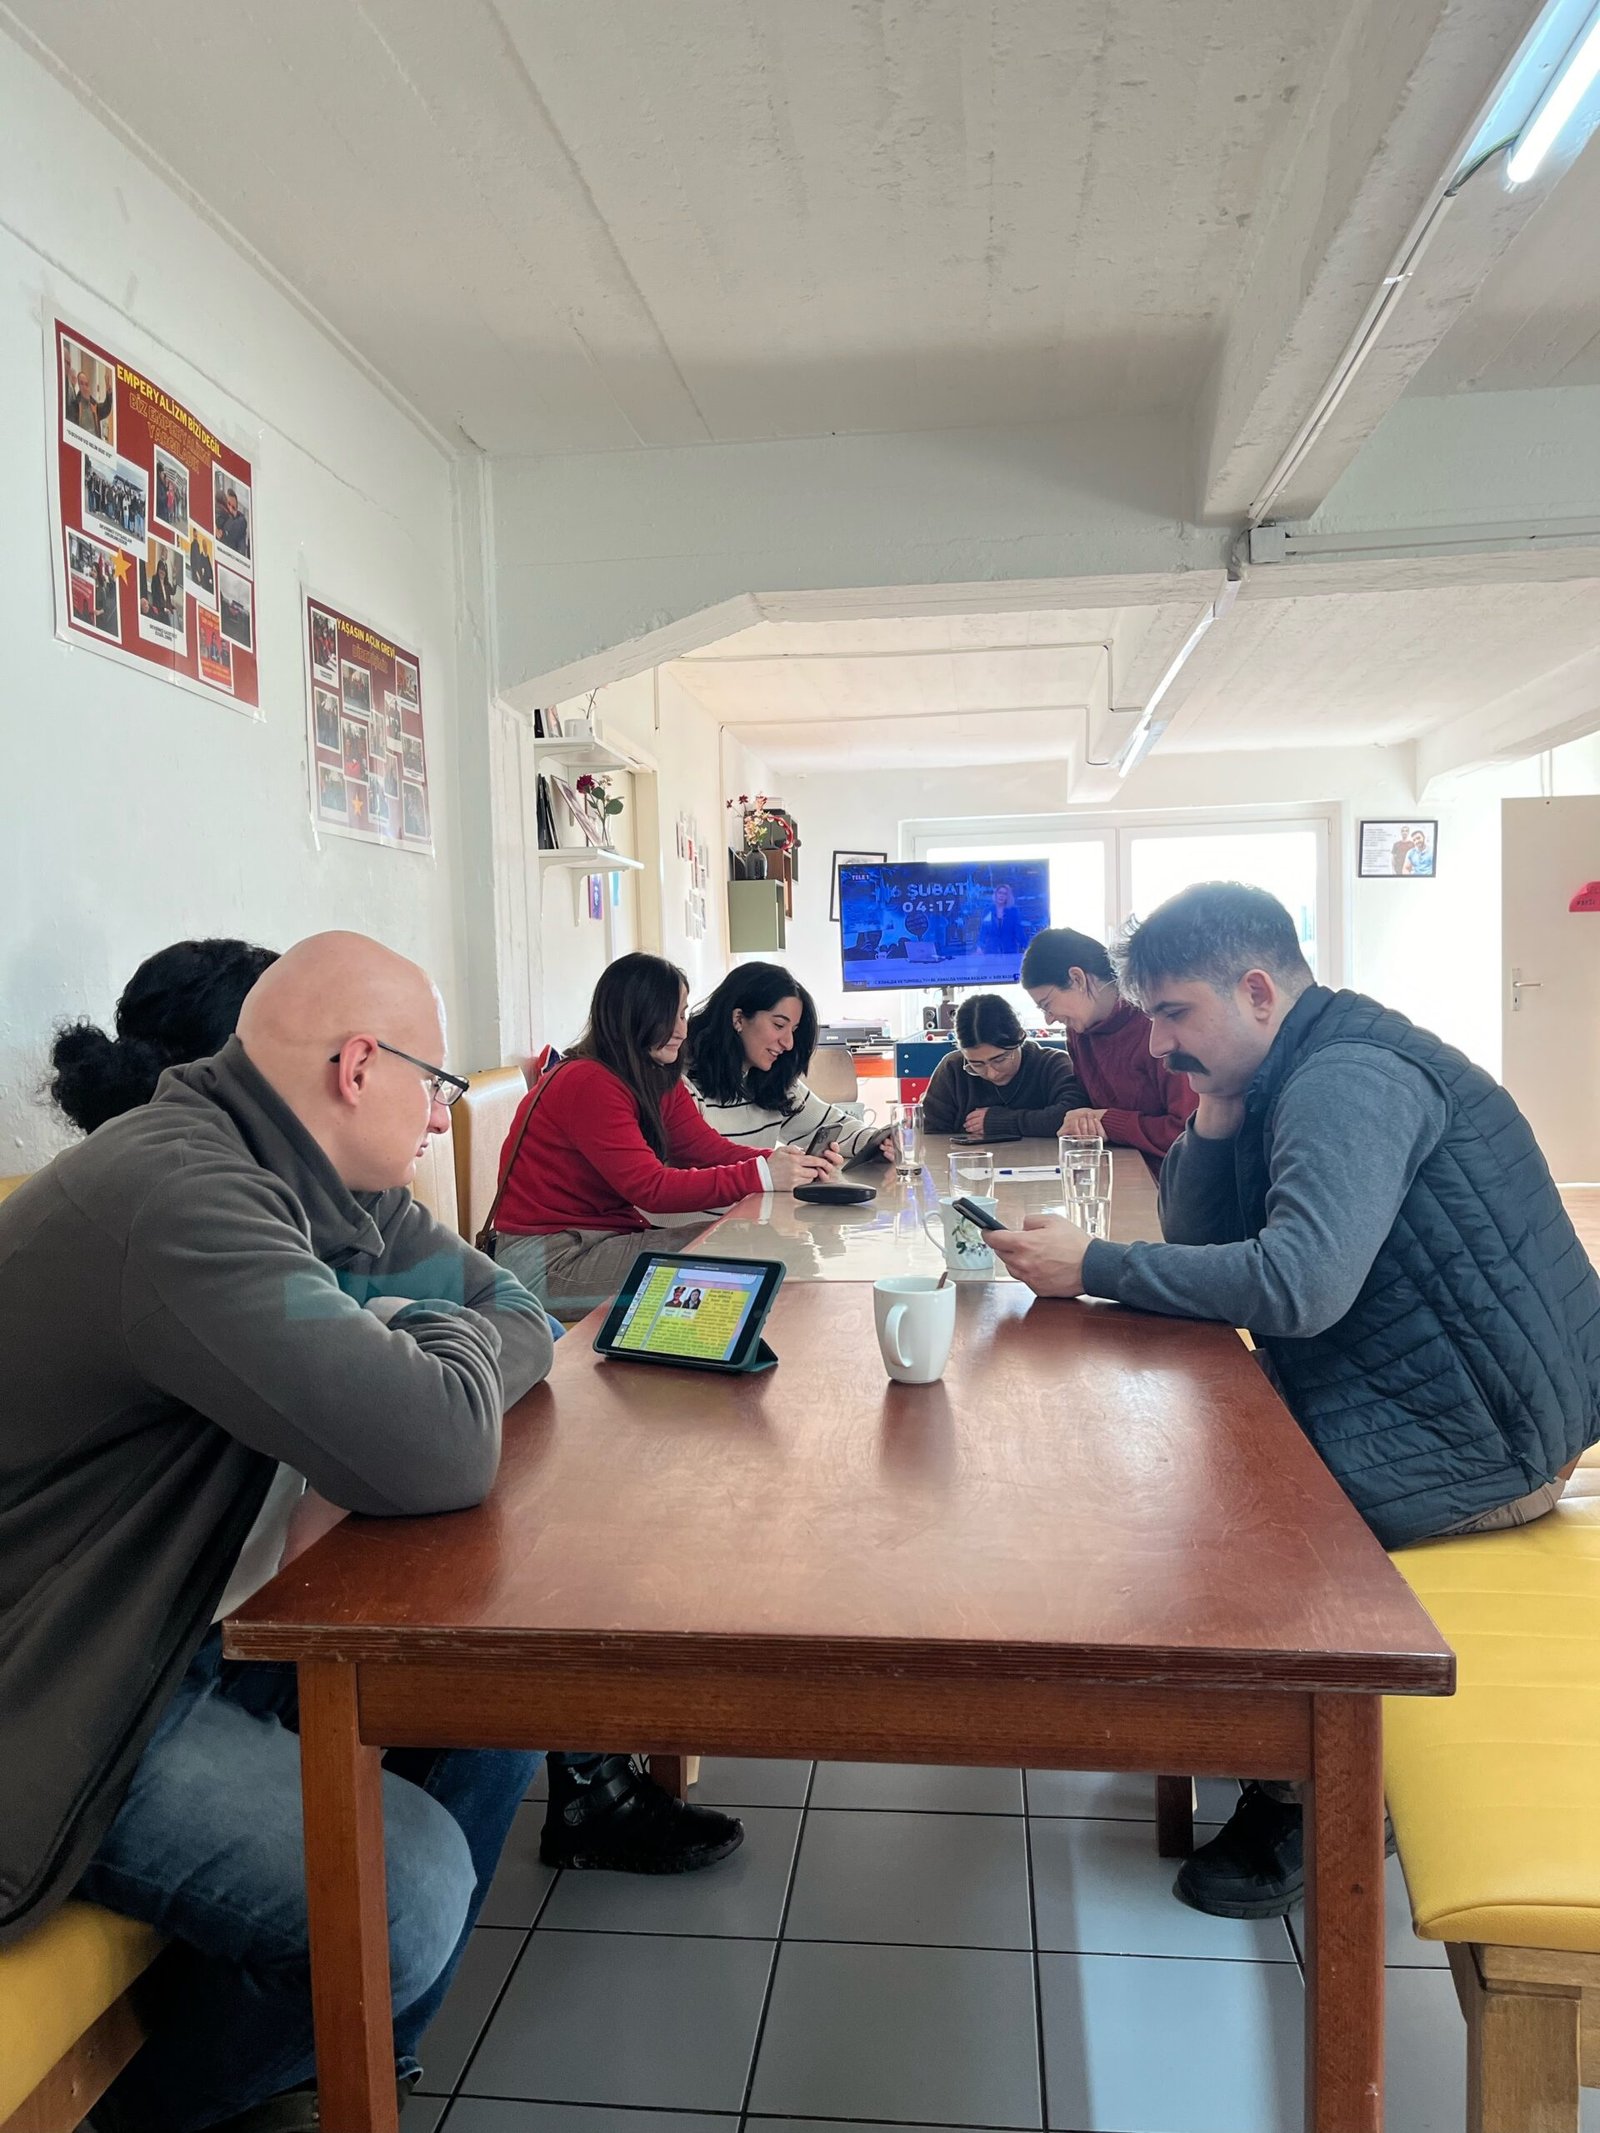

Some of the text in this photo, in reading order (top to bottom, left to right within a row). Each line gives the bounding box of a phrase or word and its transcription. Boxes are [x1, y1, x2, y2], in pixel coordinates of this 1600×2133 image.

[117, 364, 221, 458] EMPERYALİZM BİZİ DEĞİL
[129, 391, 148, 417] BİZ
[336, 617, 365, 642] YAŞASIN
[907, 882, 967, 901] ŞUBAT
[902, 900, 955, 913] 04:17
